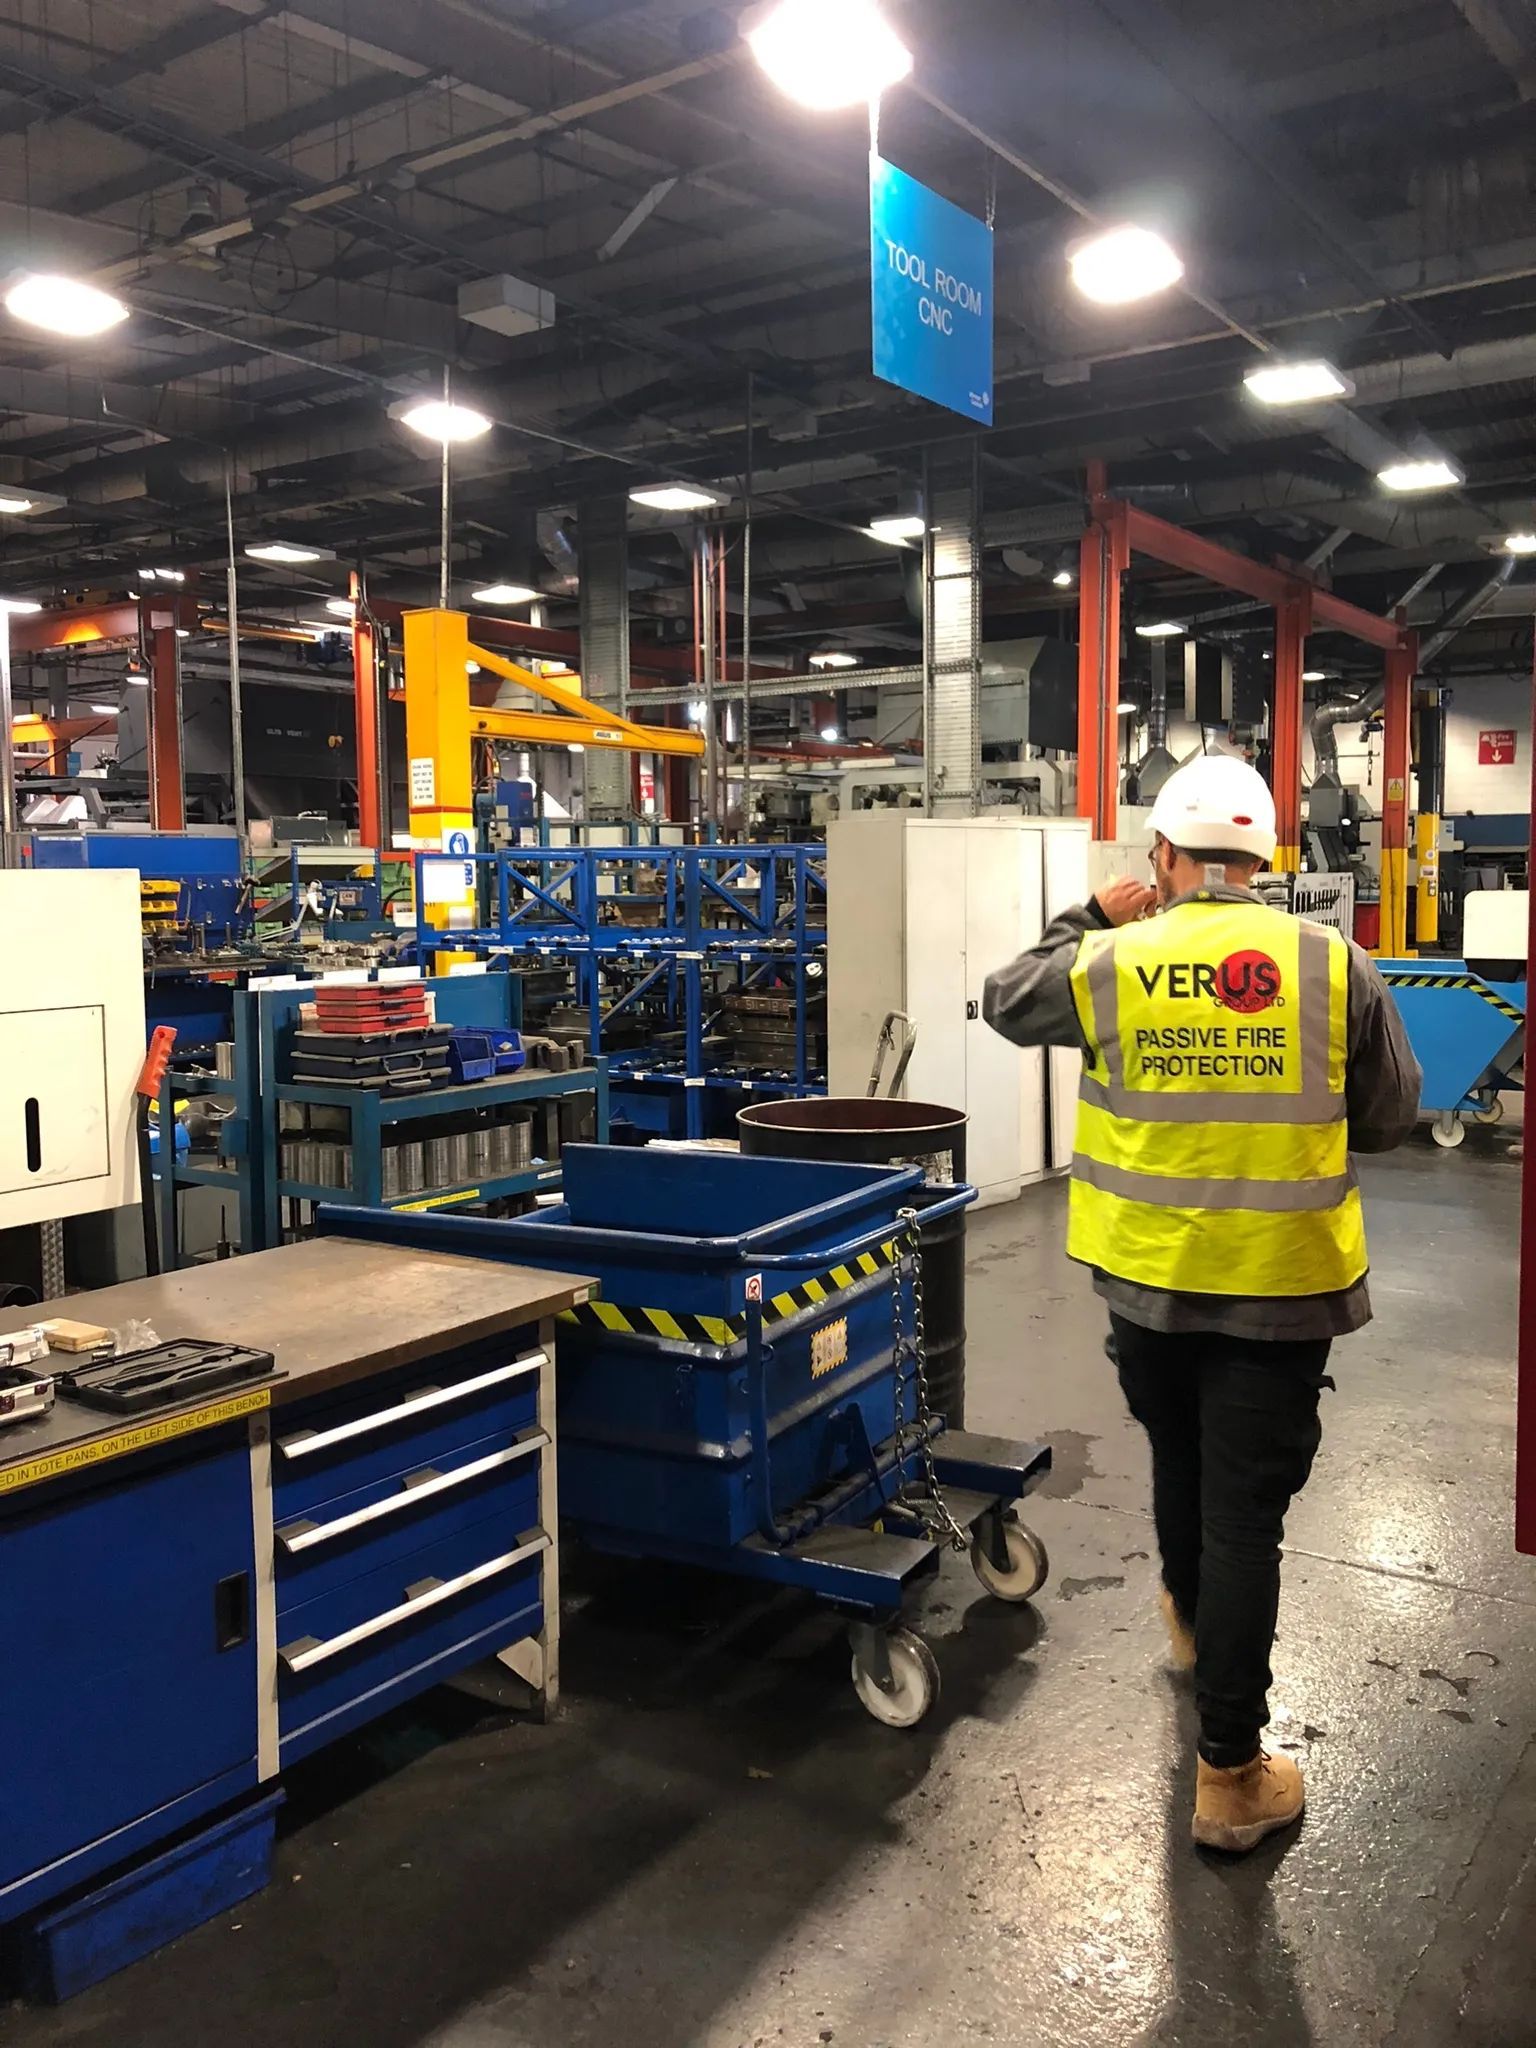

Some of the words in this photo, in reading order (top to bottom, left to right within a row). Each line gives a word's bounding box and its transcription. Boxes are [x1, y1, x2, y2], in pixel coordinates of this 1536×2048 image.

[885, 239, 930, 289] TOOL
[935, 268, 982, 317] ROOM
[918, 297, 953, 336] CNC
[1136, 962, 1277, 998] VERUS
[1136, 1027, 1227, 1049] PASSIVE
[1236, 1027, 1287, 1048] FIRE
[1141, 1055, 1284, 1076] PROTECTION
[17, 1467, 29, 1480] IN
[32, 1458, 62, 1475] TOTE
[101, 1441, 118, 1454] ON
[120, 1433, 141, 1447] THE
[144, 1424, 169, 1440] LEFT
[171, 1416, 195, 1432] SIDE
[196, 1412, 210, 1424] OF
[211, 1404, 234, 1419] THIS
[236, 1392, 269, 1411] BENCH
